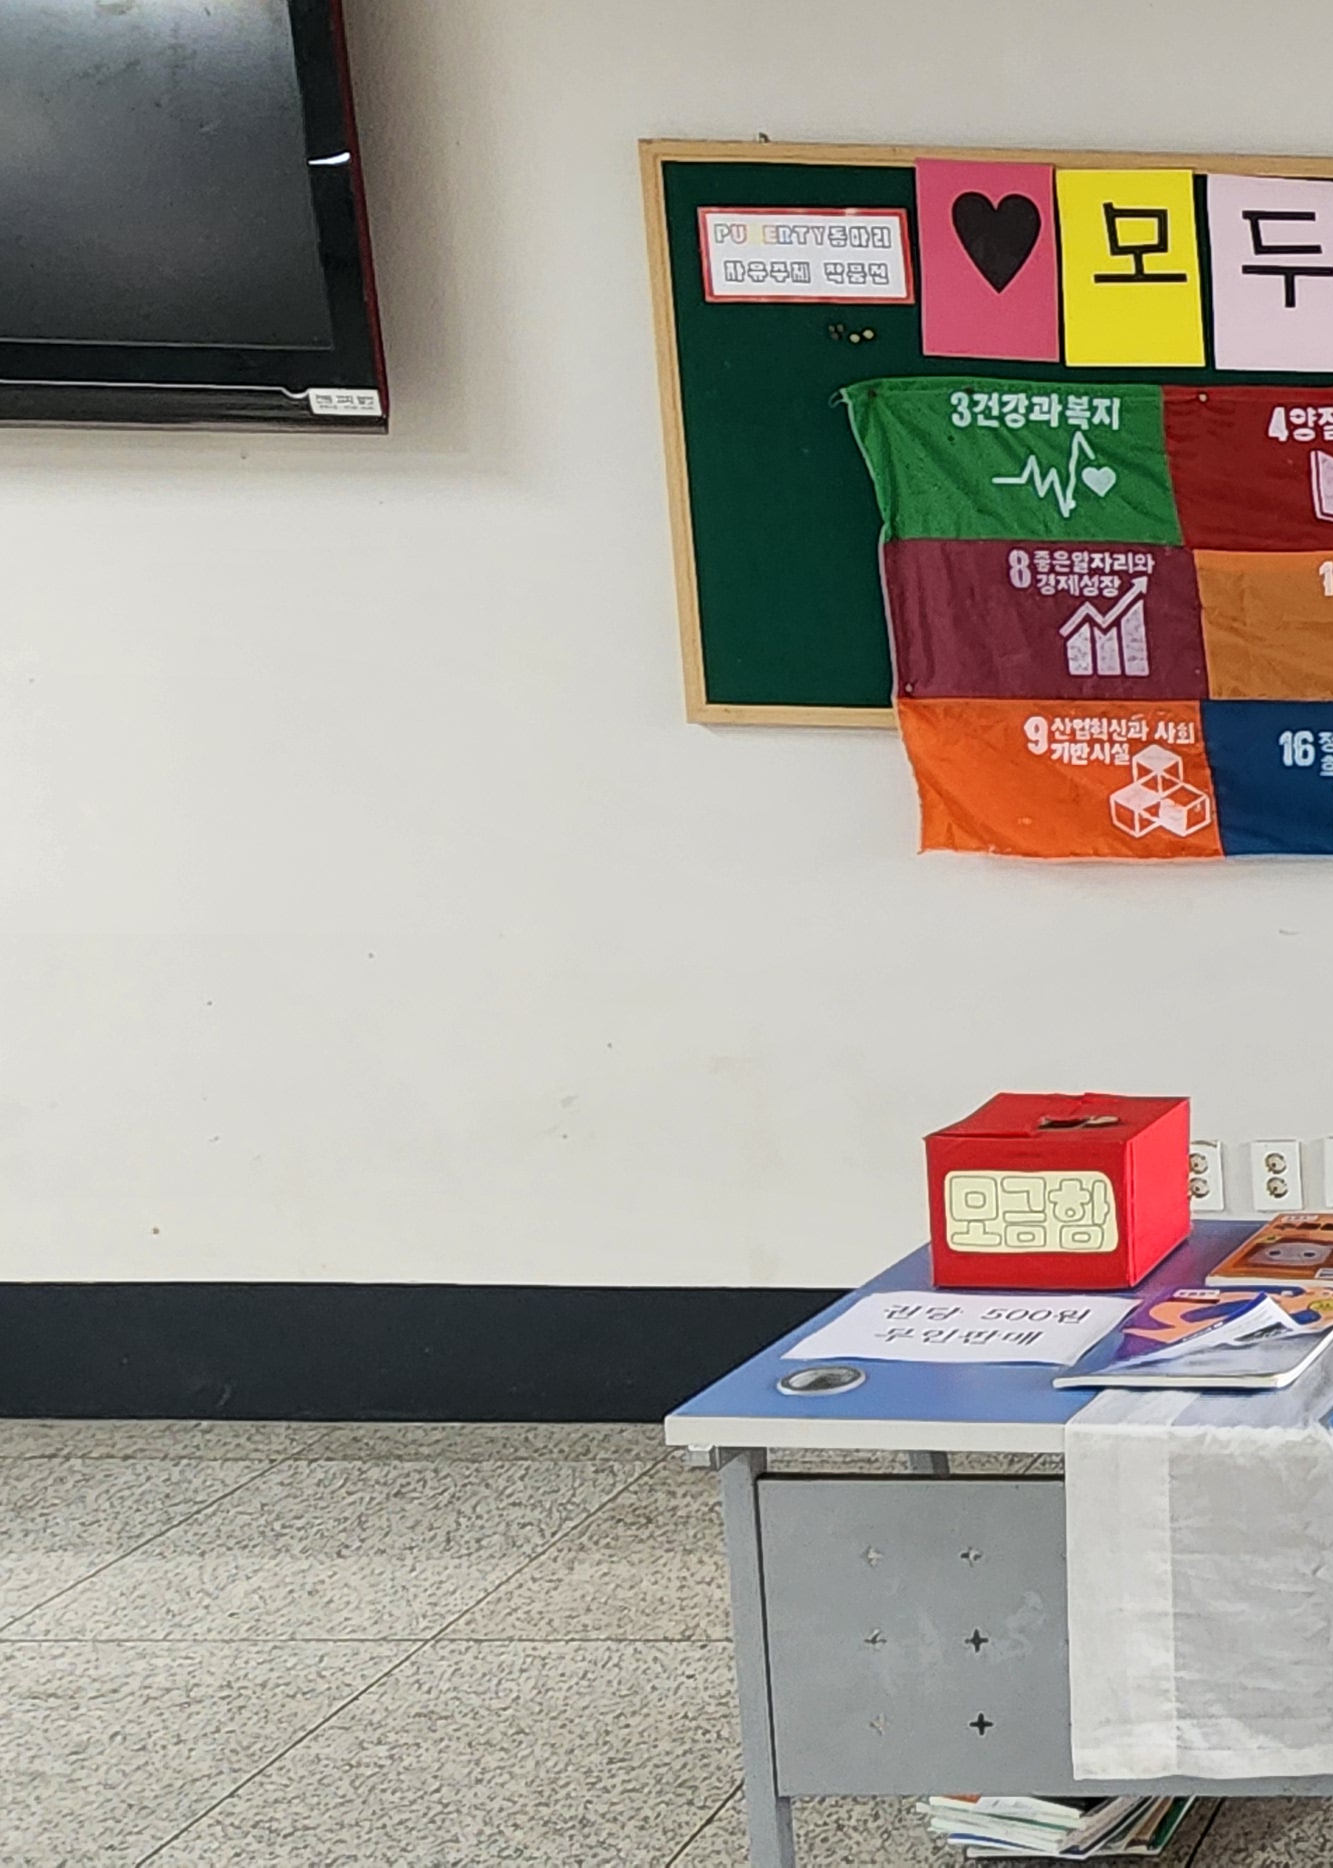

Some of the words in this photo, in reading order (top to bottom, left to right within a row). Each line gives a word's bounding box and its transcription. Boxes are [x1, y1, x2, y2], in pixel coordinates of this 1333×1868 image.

[714, 223, 891, 248] PUERTY동아리
[1008, 549, 1031, 588] 8
[1036, 574, 1121, 597] 경제성장
[1023, 716, 1048, 755] 9
[1154, 721, 1195, 744] 사회
[1279, 730, 1315, 766] 16
[949, 1175, 1110, 1250] 모금함
[980, 1307, 1091, 1324] 500원
